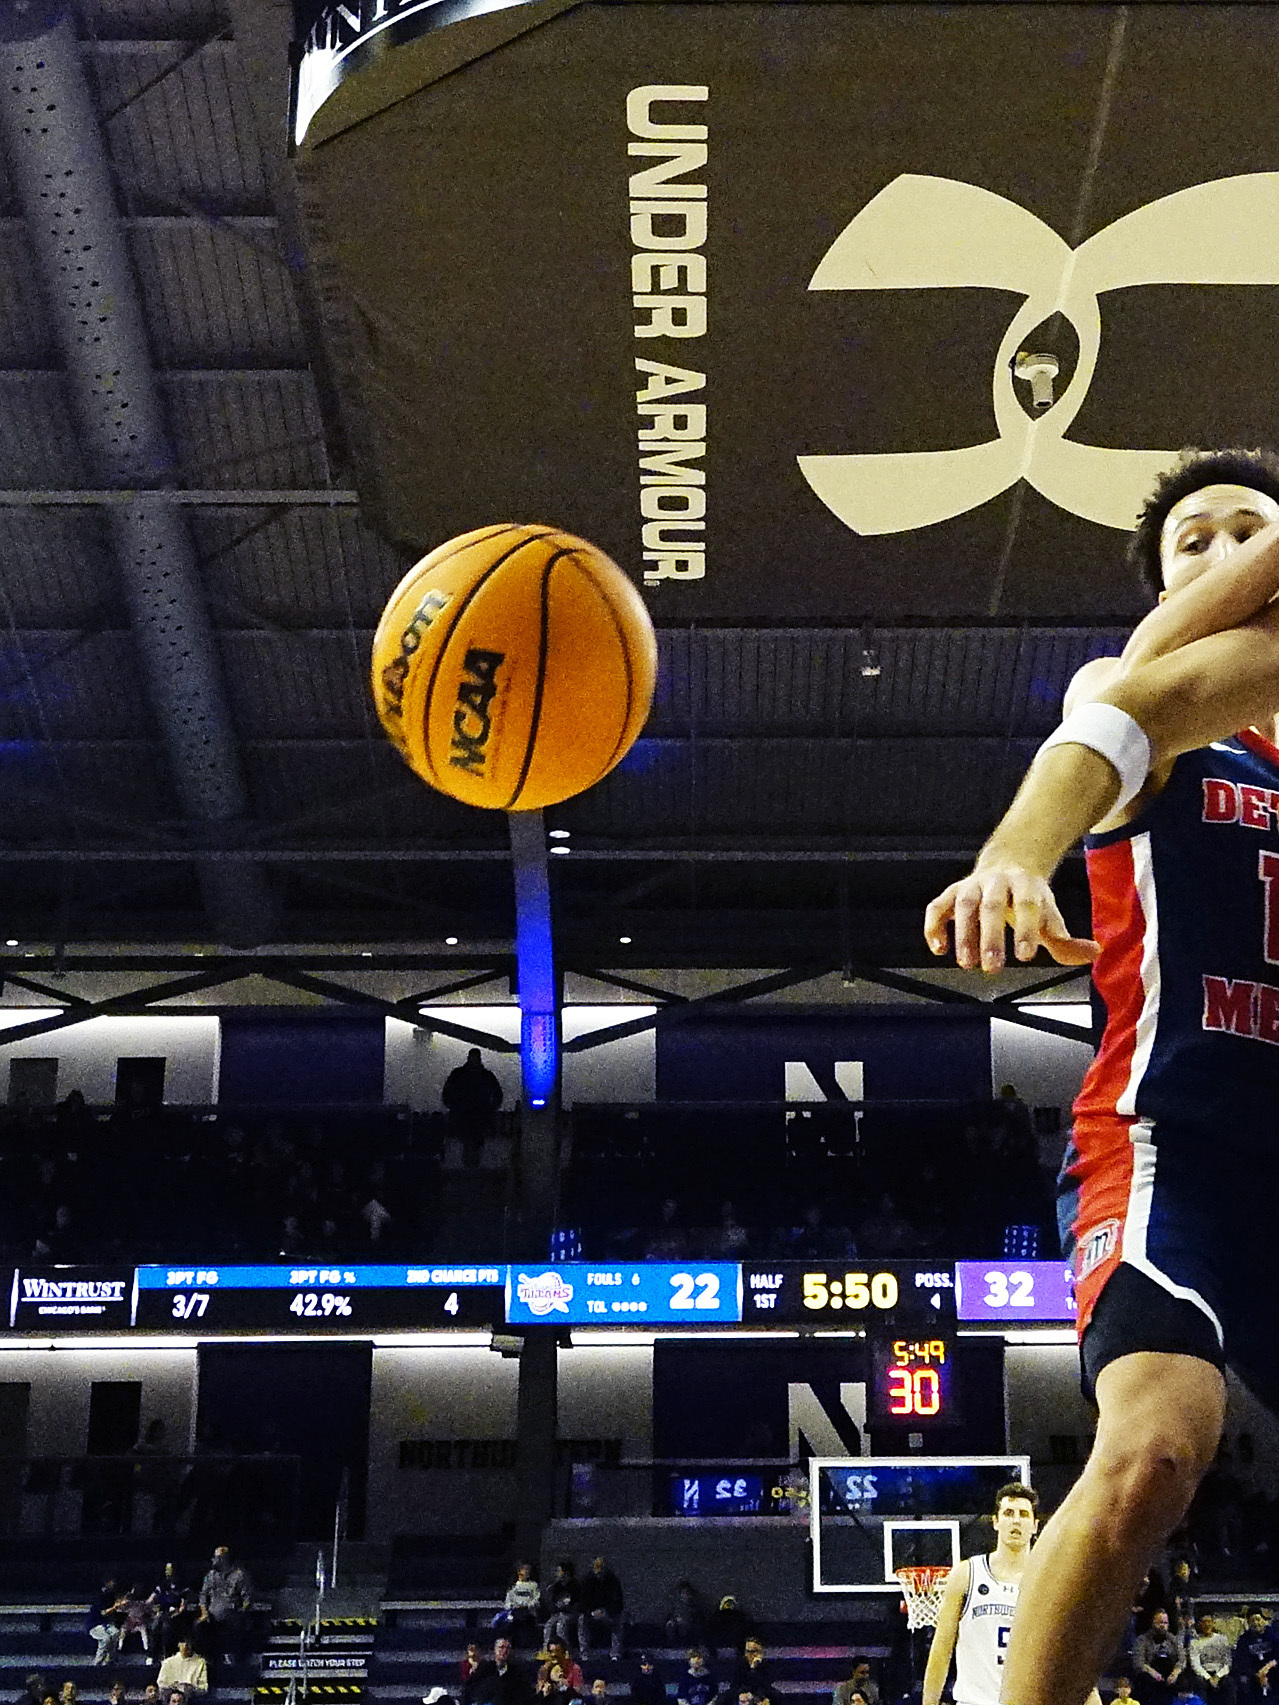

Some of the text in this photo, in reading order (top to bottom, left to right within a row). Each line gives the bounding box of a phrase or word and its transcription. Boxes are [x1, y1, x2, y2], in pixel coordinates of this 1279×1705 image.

[626, 85, 708, 582] UNDER ARMOUR
[449, 647, 506, 777] NCAA
[22, 1278, 126, 1298] WINTRUST
[587, 1273, 640, 1286] FOULS 6
[669, 1272, 721, 1310] 22
[750, 1274, 784, 1289] HALF
[802, 1272, 899, 1310] 5:50
[915, 1272, 955, 1288] POSS.
[983, 1271, 1036, 1308] 32
[171, 1292, 210, 1319] 3/7
[289, 1292, 352, 1317] 42.9%
[444, 1292, 459, 1316] 4
[753, 1293, 777, 1309] 1ST
[893, 1340, 946, 1367] 5:49
[888, 1369, 940, 1416] 30
